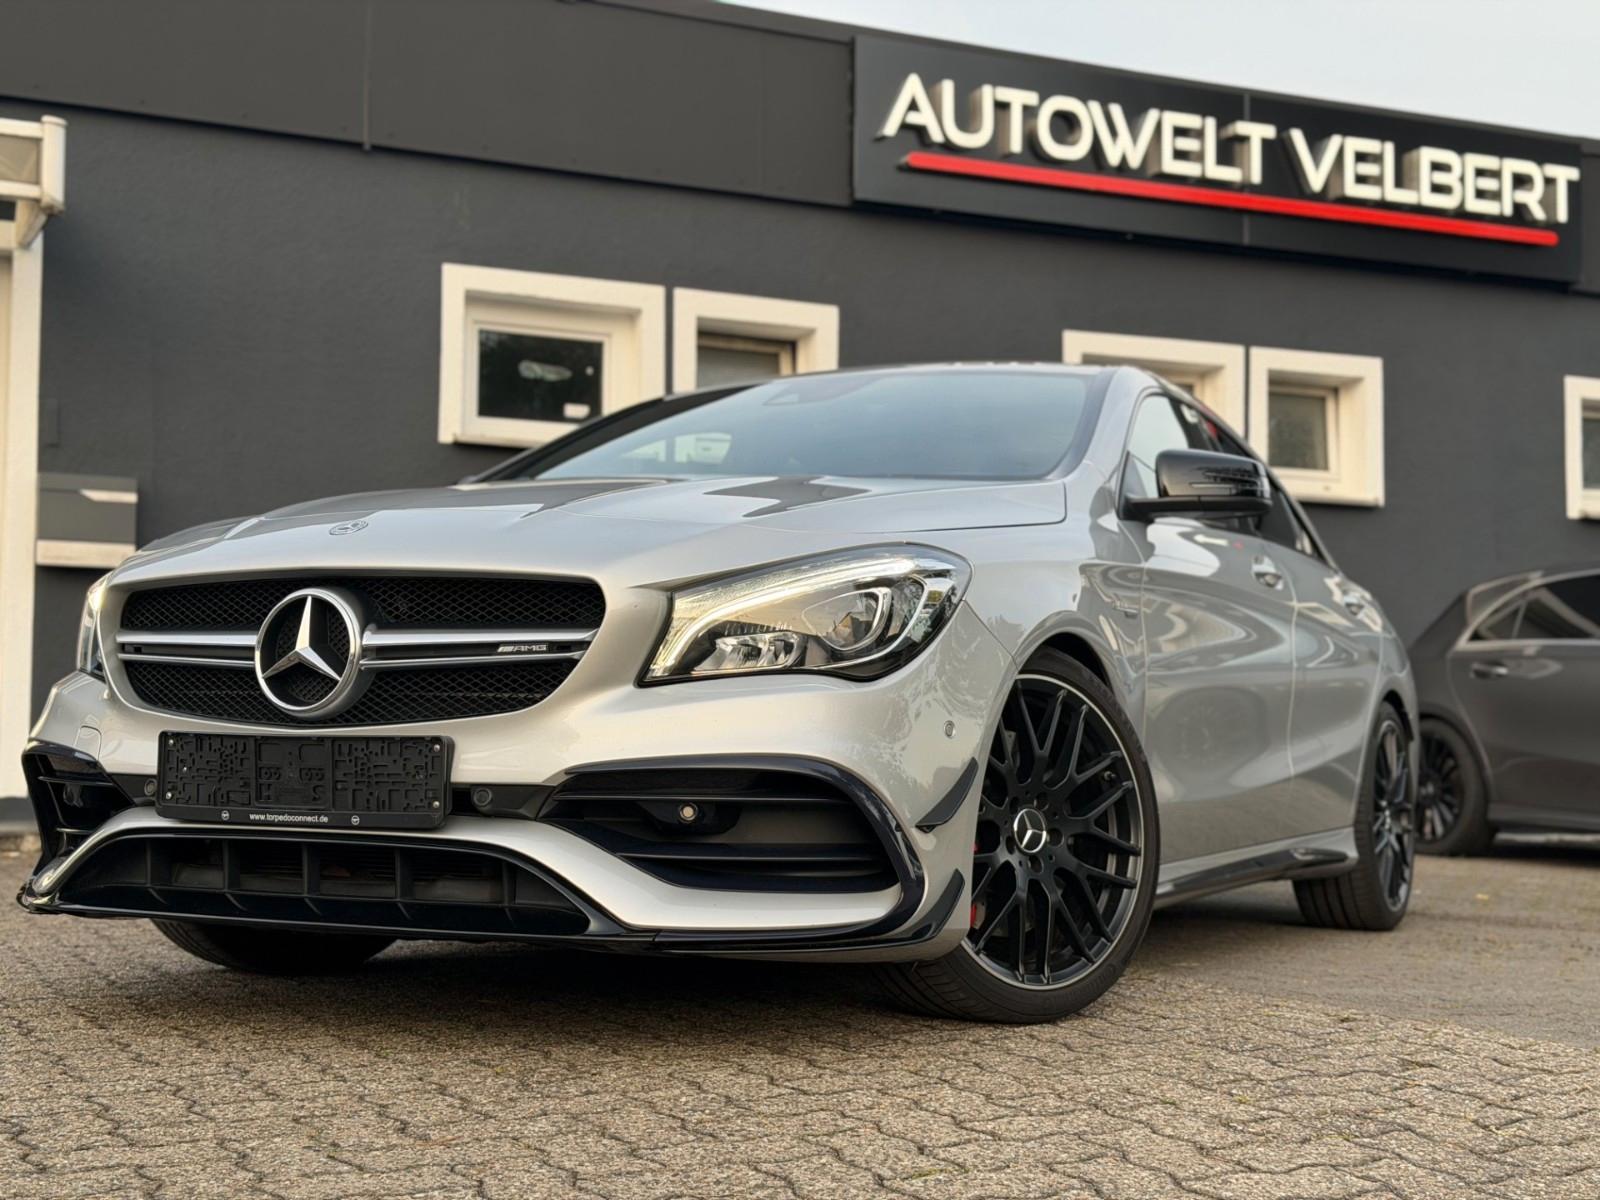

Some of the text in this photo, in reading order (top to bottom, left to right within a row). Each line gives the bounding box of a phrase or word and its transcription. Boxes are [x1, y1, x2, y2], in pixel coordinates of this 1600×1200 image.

[880, 72, 1581, 224] AUTOWELT VELBERT
[510, 644, 547, 652] AMG
[249, 812, 329, 823] www.torpedoconnect.de
